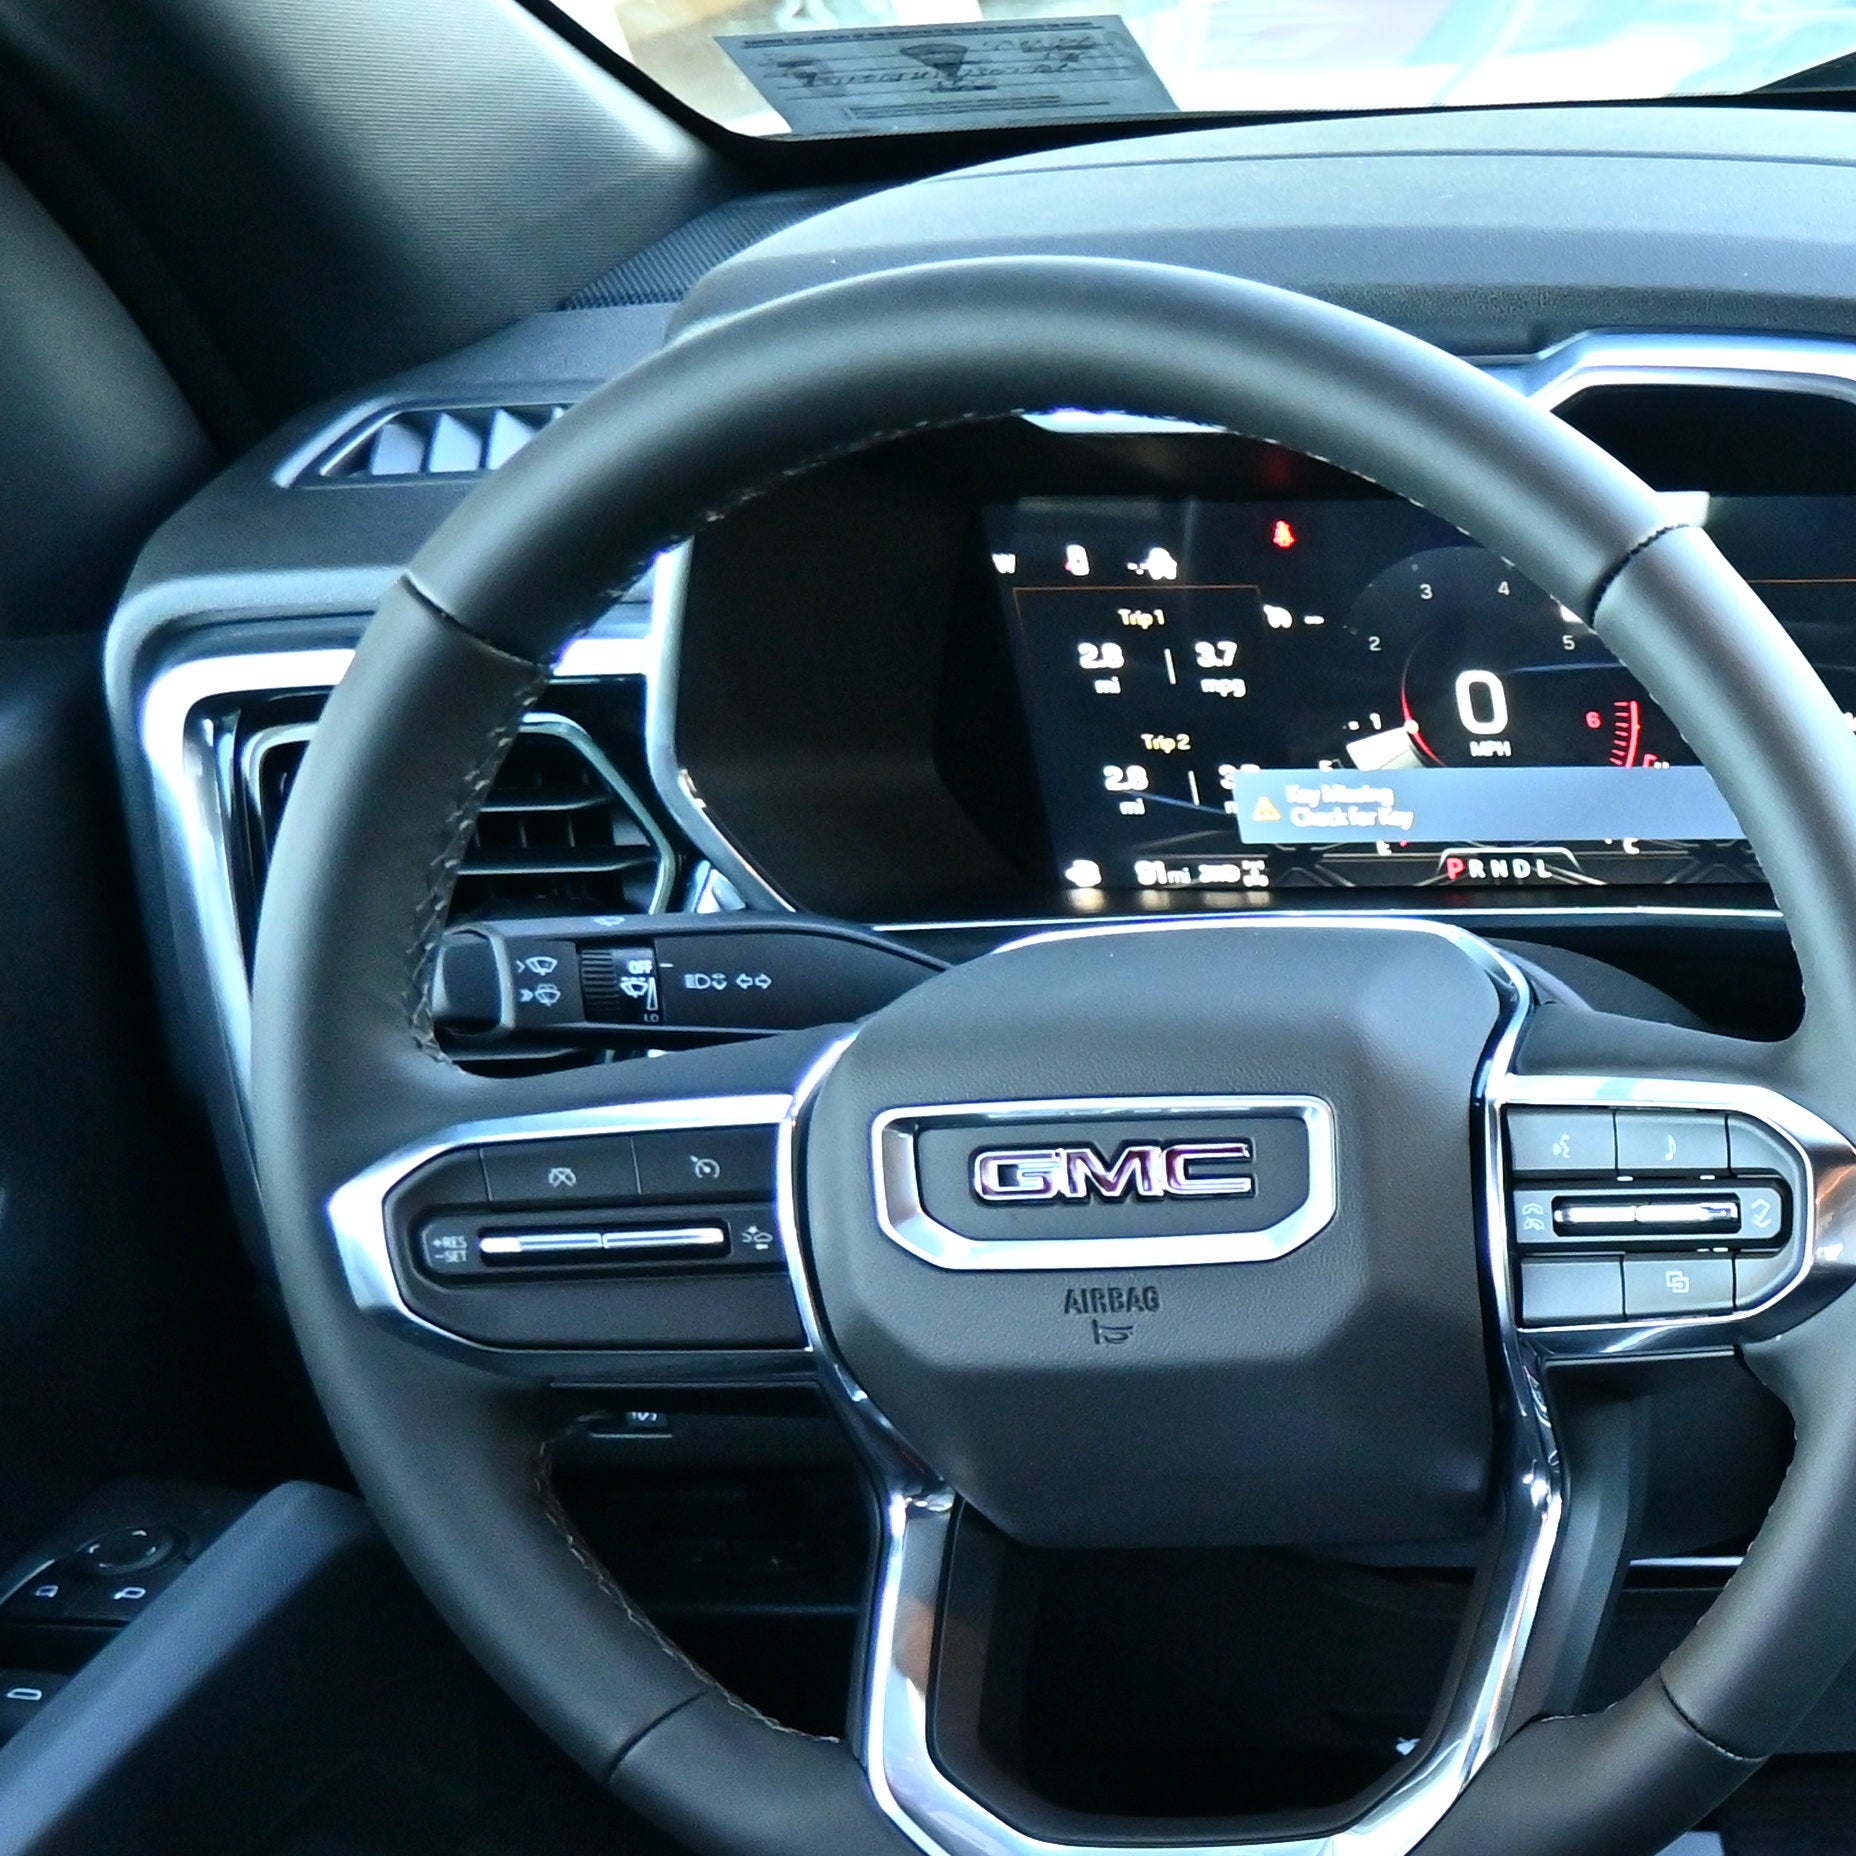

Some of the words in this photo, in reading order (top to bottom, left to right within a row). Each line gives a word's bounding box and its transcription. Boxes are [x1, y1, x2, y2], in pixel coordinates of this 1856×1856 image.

[1420, 584, 1433, 599] 3
[1498, 581, 1510, 595] 4
[1117, 608, 1153, 630] Trip
[1153, 609, 1165, 625] 1
[1368, 636, 1382, 651] 2
[1563, 635, 1575, 650] 5
[1094, 676, 1121, 694] mi
[1200, 678, 1247, 697] mpg
[1455, 669, 1508, 735] 0
[1585, 711, 1601, 728] 6
[1140, 733, 1176, 754] Trip
[1176, 734, 1191, 750] 2
[1470, 741, 1512, 757] MPH
[1119, 798, 1145, 815] mi
[1447, 857, 1466, 881] P
[1468, 859, 1486, 878] R
[1490, 859, 1508, 878] N
[1513, 859, 1531, 879] D
[1536, 859, 1552, 879] L
[627, 960, 652, 973] OFF
[973, 1142, 1252, 1201] GMC
[1063, 1286, 1161, 1314] AIRBAG
